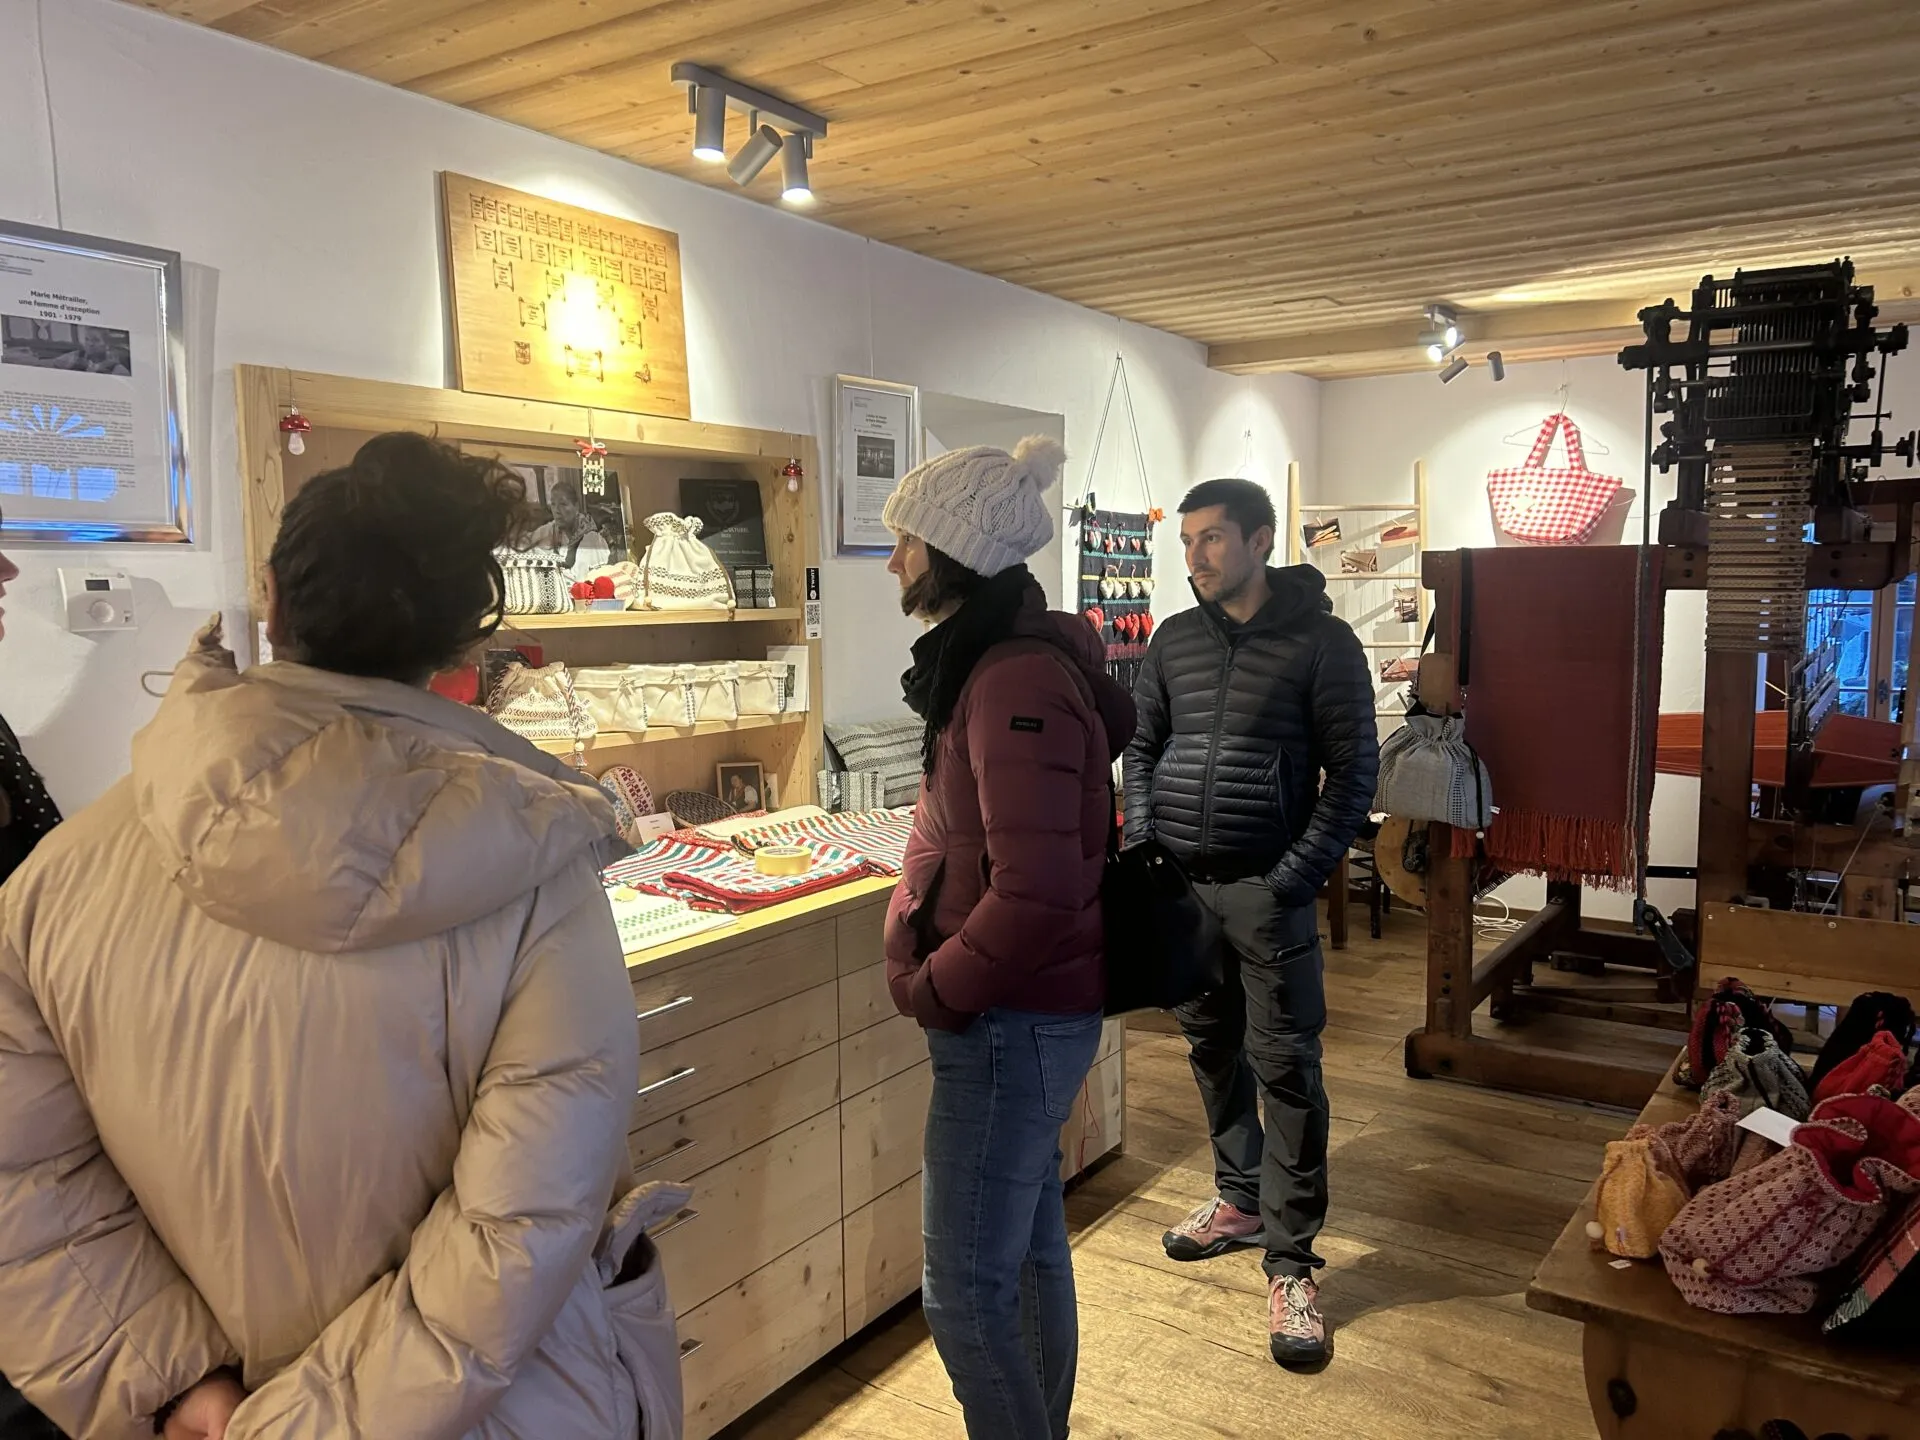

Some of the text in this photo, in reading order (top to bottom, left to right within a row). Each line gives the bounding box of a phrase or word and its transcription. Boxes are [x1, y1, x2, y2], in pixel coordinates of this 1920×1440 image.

[30, 290, 51, 299] Marie
[33, 299, 59, 309] femme
[60, 303, 100, 315] d'exception
[39, 310, 57, 318] 1901
[64, 313, 82, 321] 1979
